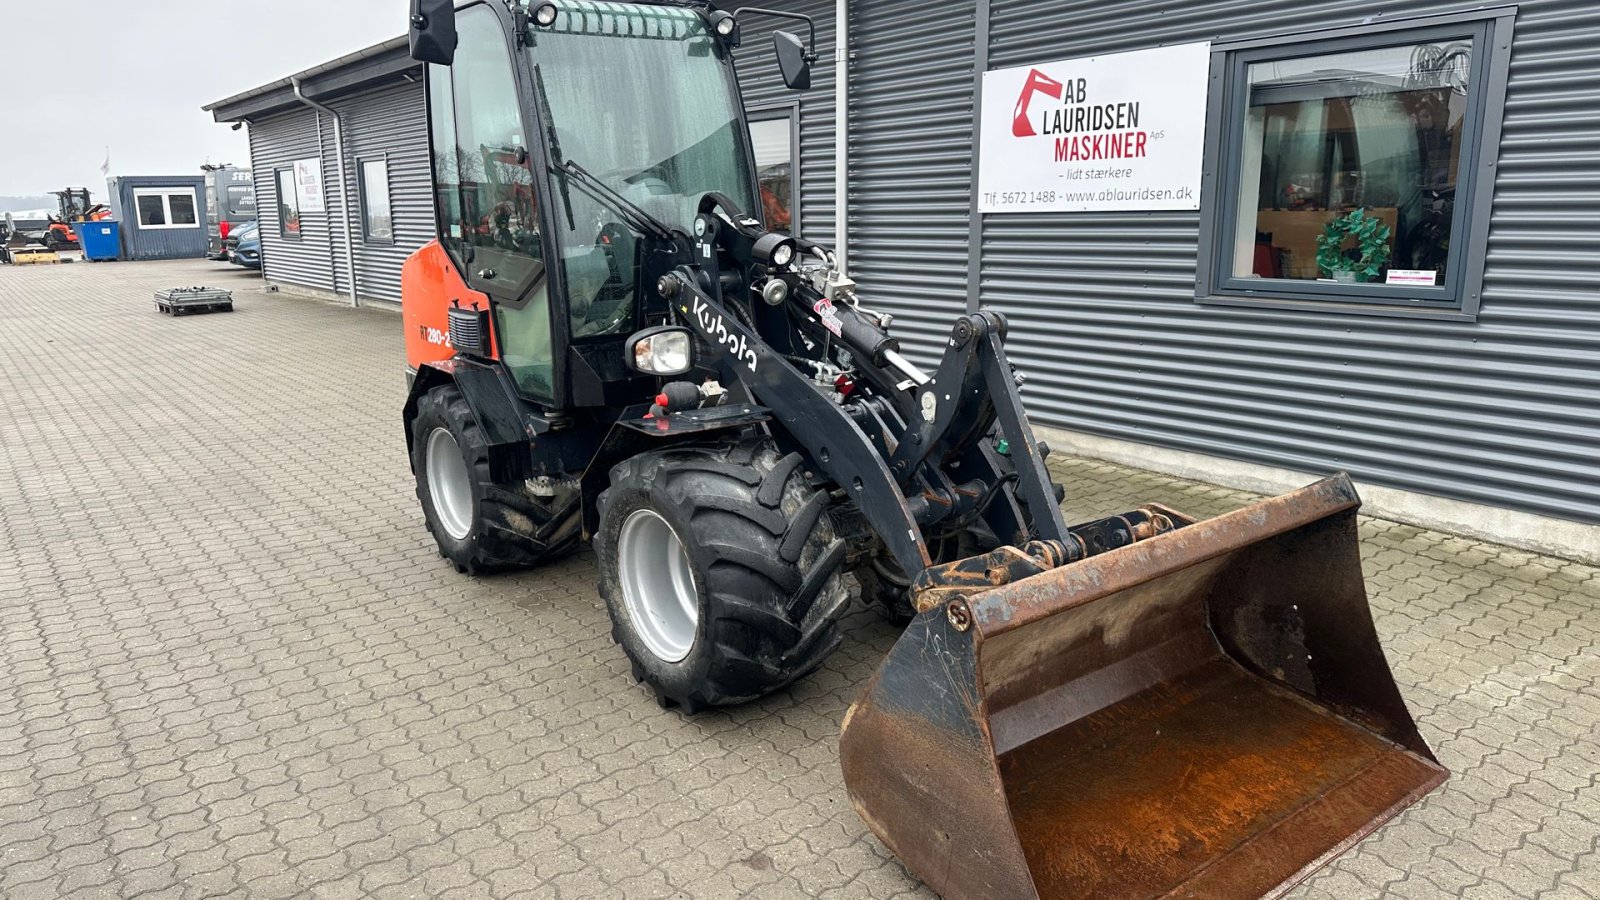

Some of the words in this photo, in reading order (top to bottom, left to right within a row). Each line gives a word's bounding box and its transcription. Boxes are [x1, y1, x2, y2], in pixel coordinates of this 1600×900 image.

[1064, 77, 1087, 105] AB
[1043, 101, 1139, 135] LAURIDSEN
[1054, 131, 1147, 163] MASKINER
[1149, 130, 1165, 141] ApS
[1066, 167, 1083, 181] lidt
[1084, 166, 1133, 180] stærkere
[984, 192, 999, 205] Tlf.
[1001, 191, 1027, 205] 5672
[1029, 190, 1056, 204] 1488
[1065, 186, 1193, 203] www.ablauridsen.dk
[692, 295, 758, 373] Kubota
